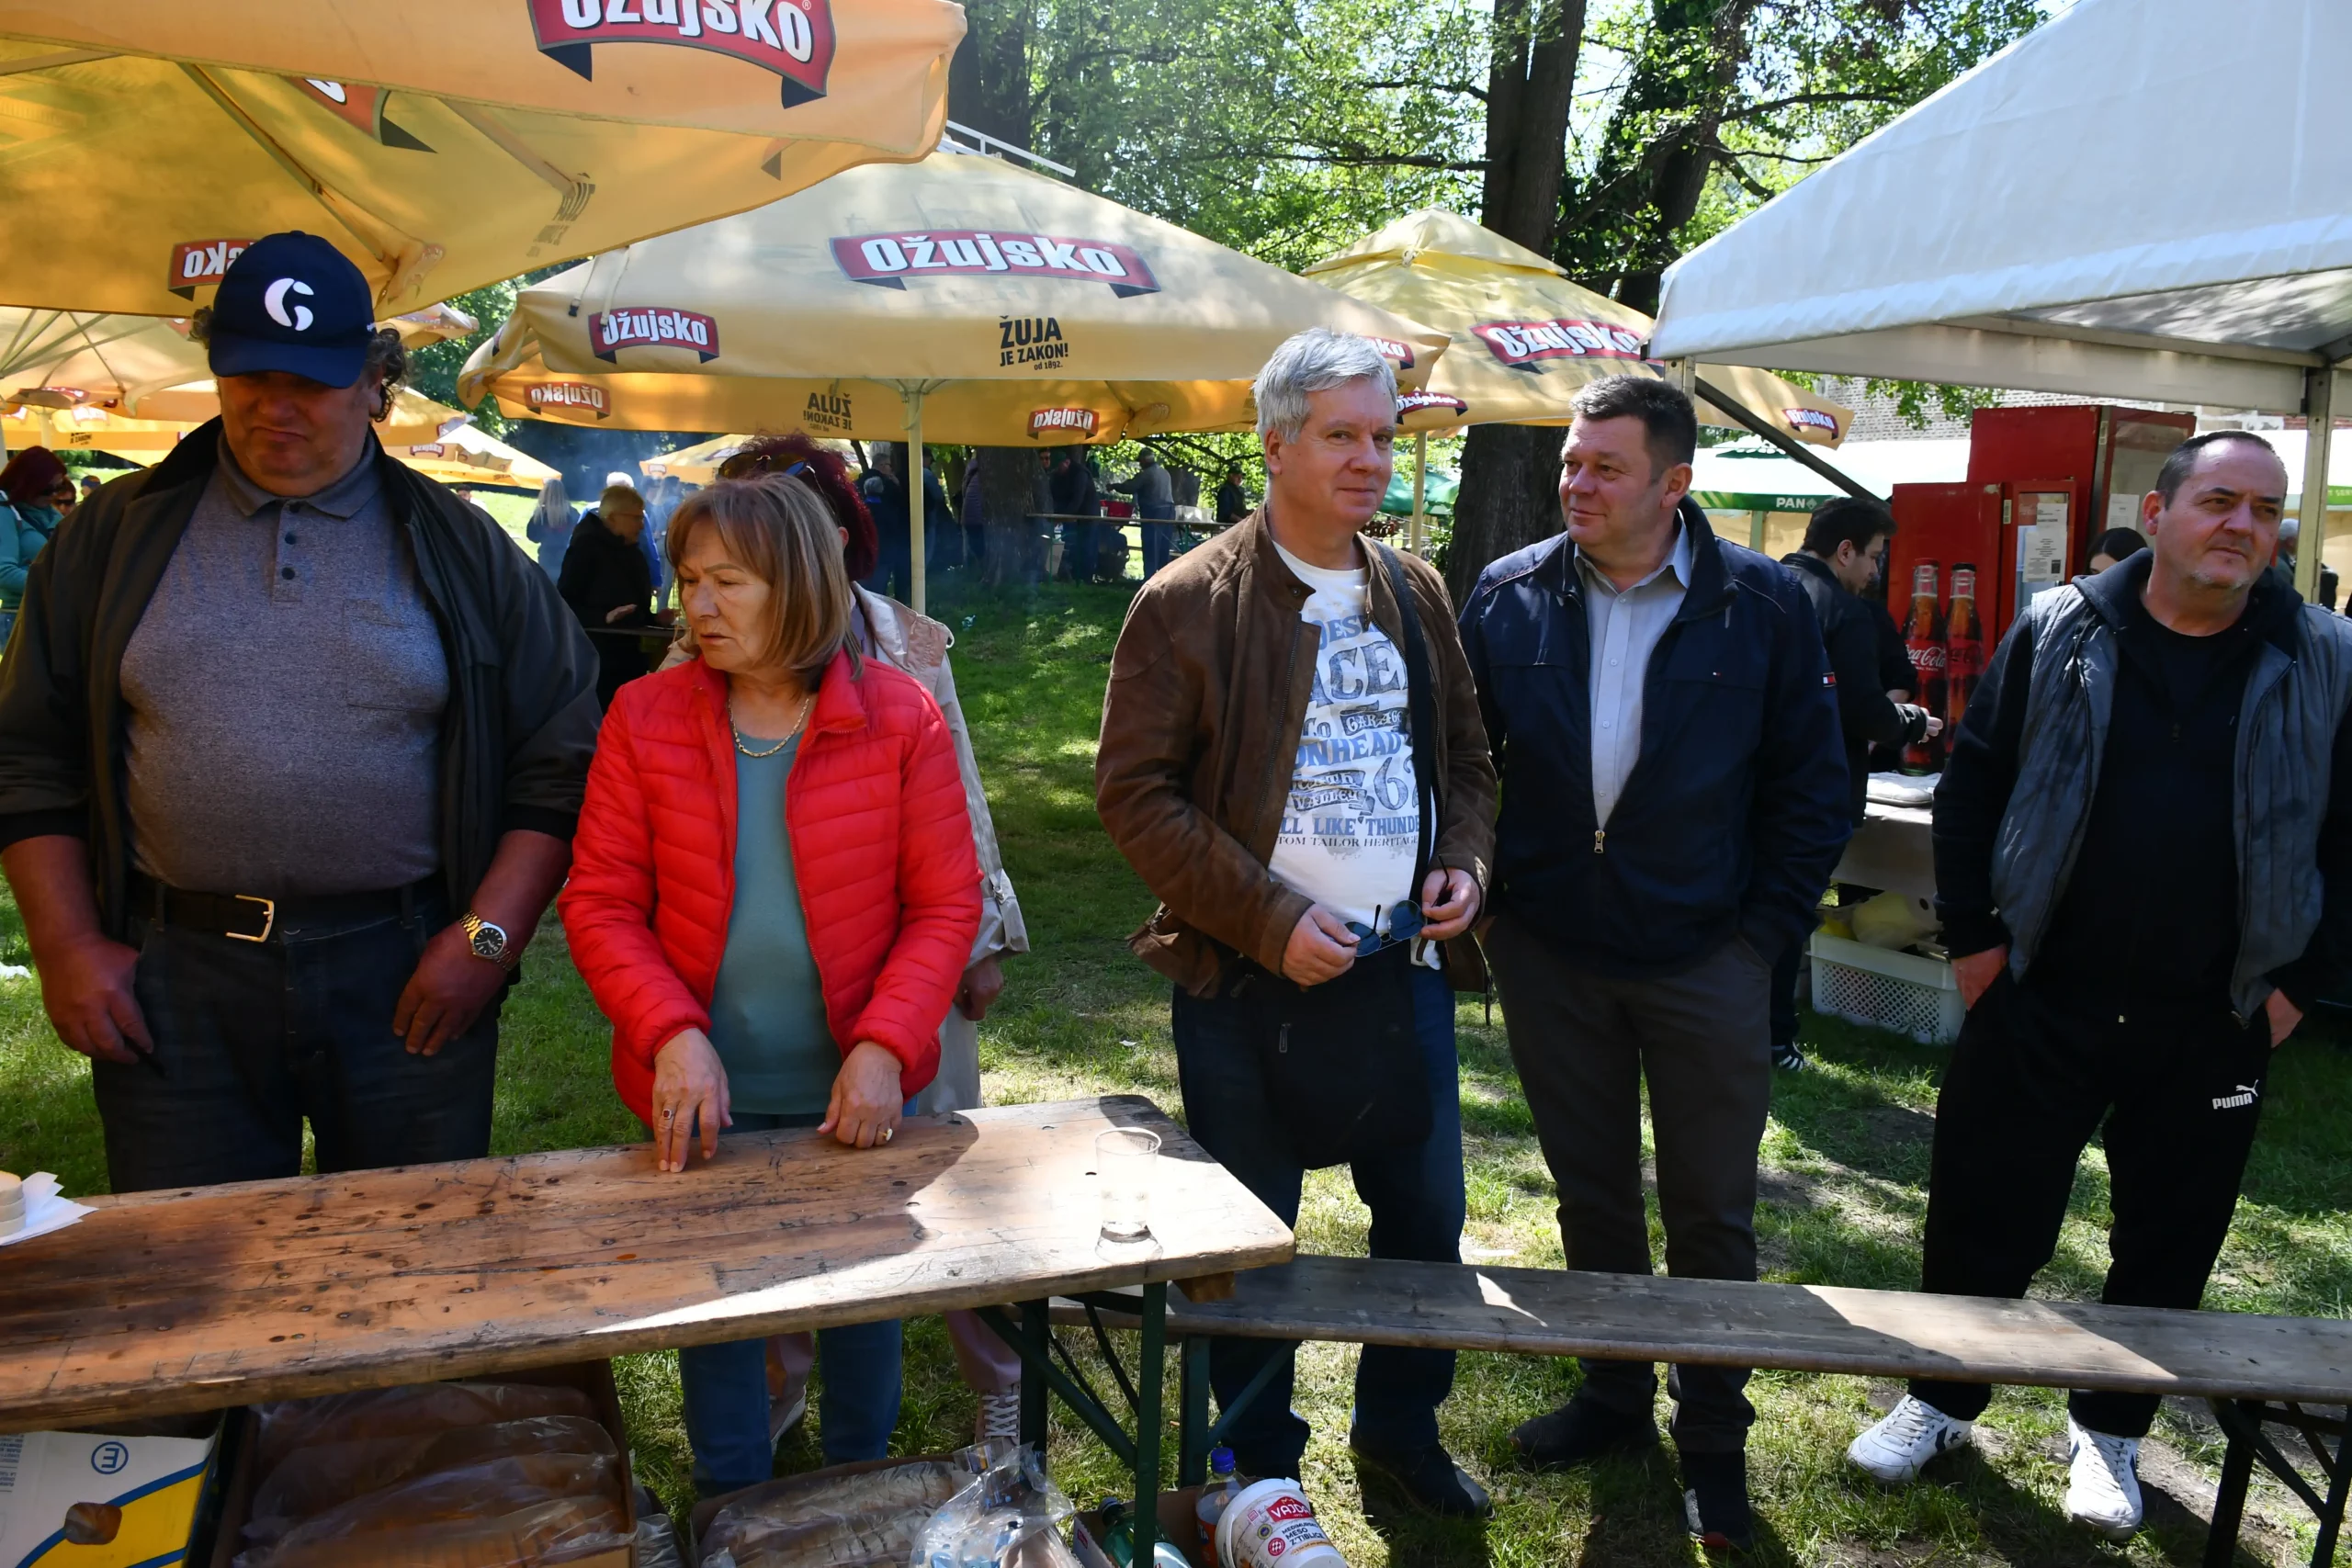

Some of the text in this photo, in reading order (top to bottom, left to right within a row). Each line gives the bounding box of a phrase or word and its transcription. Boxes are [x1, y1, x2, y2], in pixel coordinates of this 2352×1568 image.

[861, 233, 1127, 276] Ožujsko
[602, 310, 708, 346] Ožujsko
[999, 314, 1063, 349] ŽUJA
[1487, 321, 1641, 357] Ožujsko
[1000, 343, 1069, 367] JE ZAKON!
[1034, 360, 1063, 370] od 1892.
[1776, 497, 1806, 509] PAN
[1295, 731, 1402, 770] ONHEAD
[1313, 817, 1358, 836] LIKE
[1365, 815, 1420, 836] THUNDE
[1310, 837, 1360, 847] TAILOR
[1364, 836, 1418, 847] HERITAGE
[2212, 1092, 2253, 1110] PUMA
[1285, 1527, 1308, 1540] MESO
